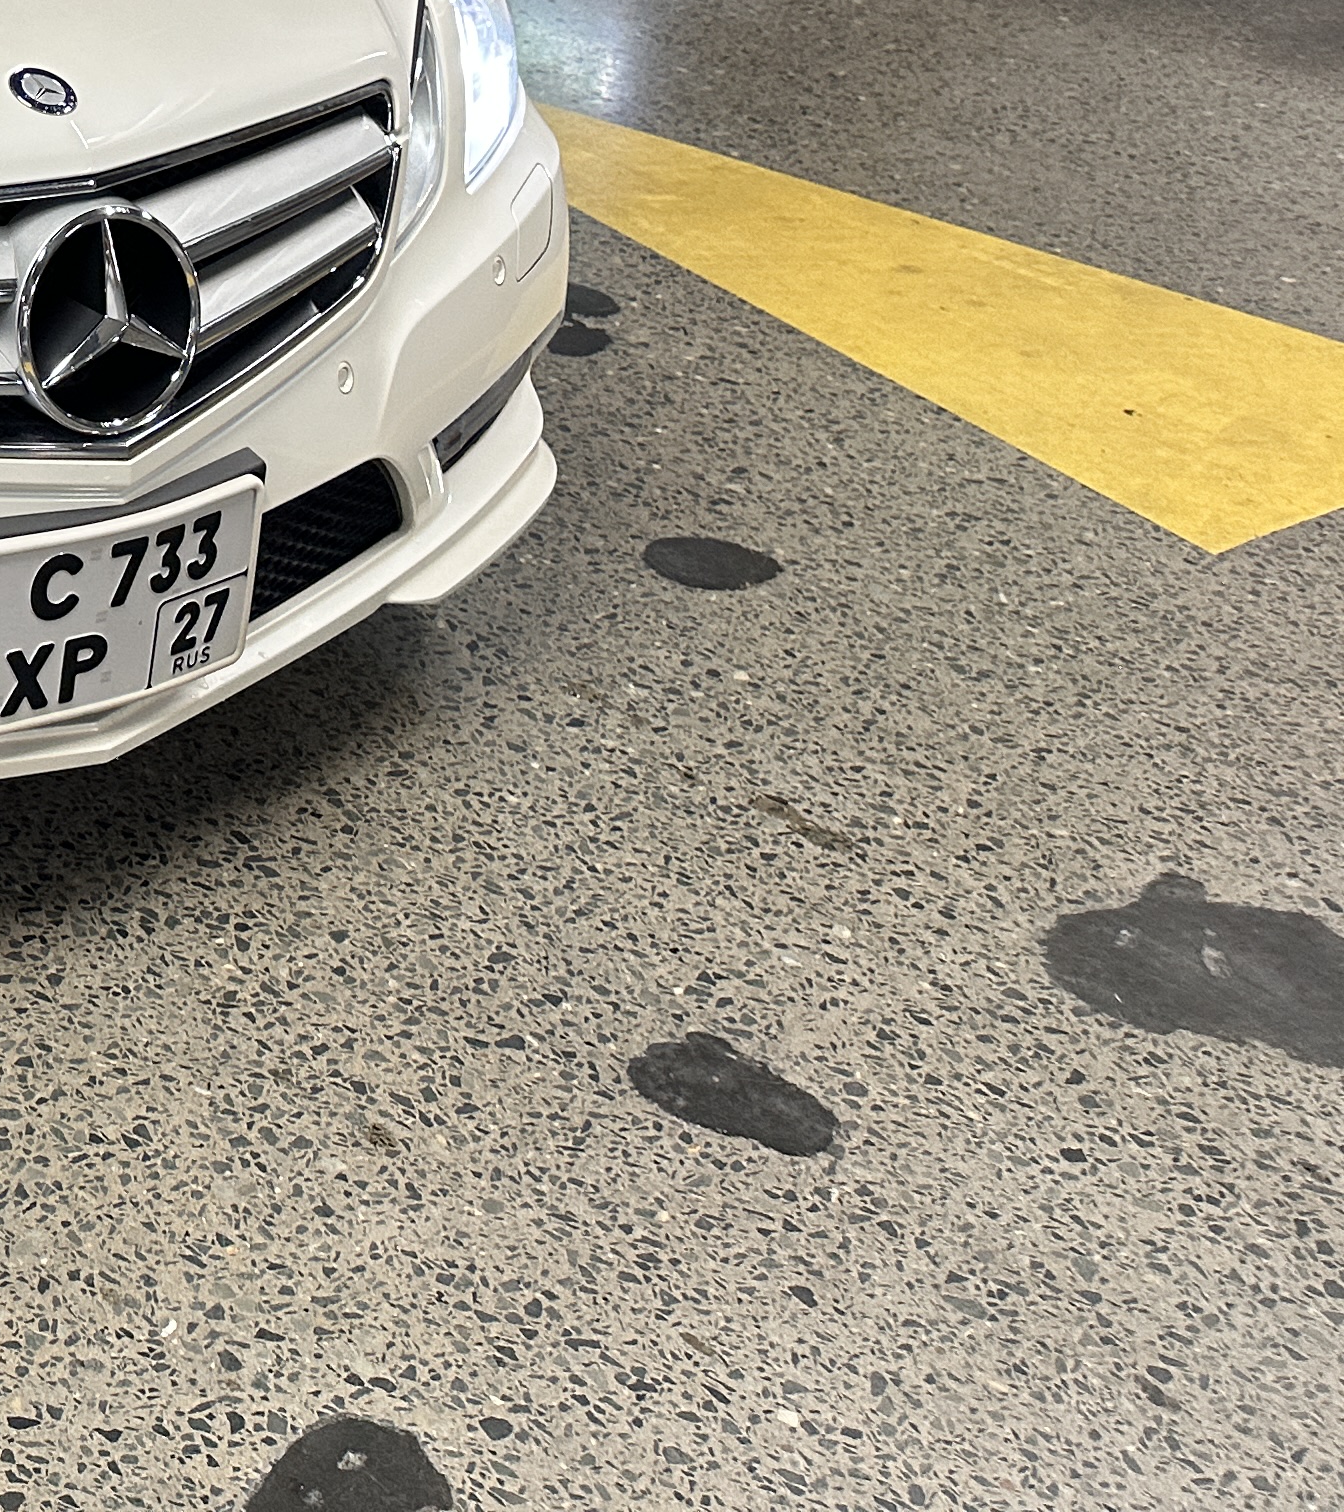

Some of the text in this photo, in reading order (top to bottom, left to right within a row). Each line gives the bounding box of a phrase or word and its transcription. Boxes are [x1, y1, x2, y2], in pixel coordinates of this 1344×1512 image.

[110, 510, 222, 608] 733
[170, 588, 230, 656] 27
[172, 646, 210, 675] RUS
